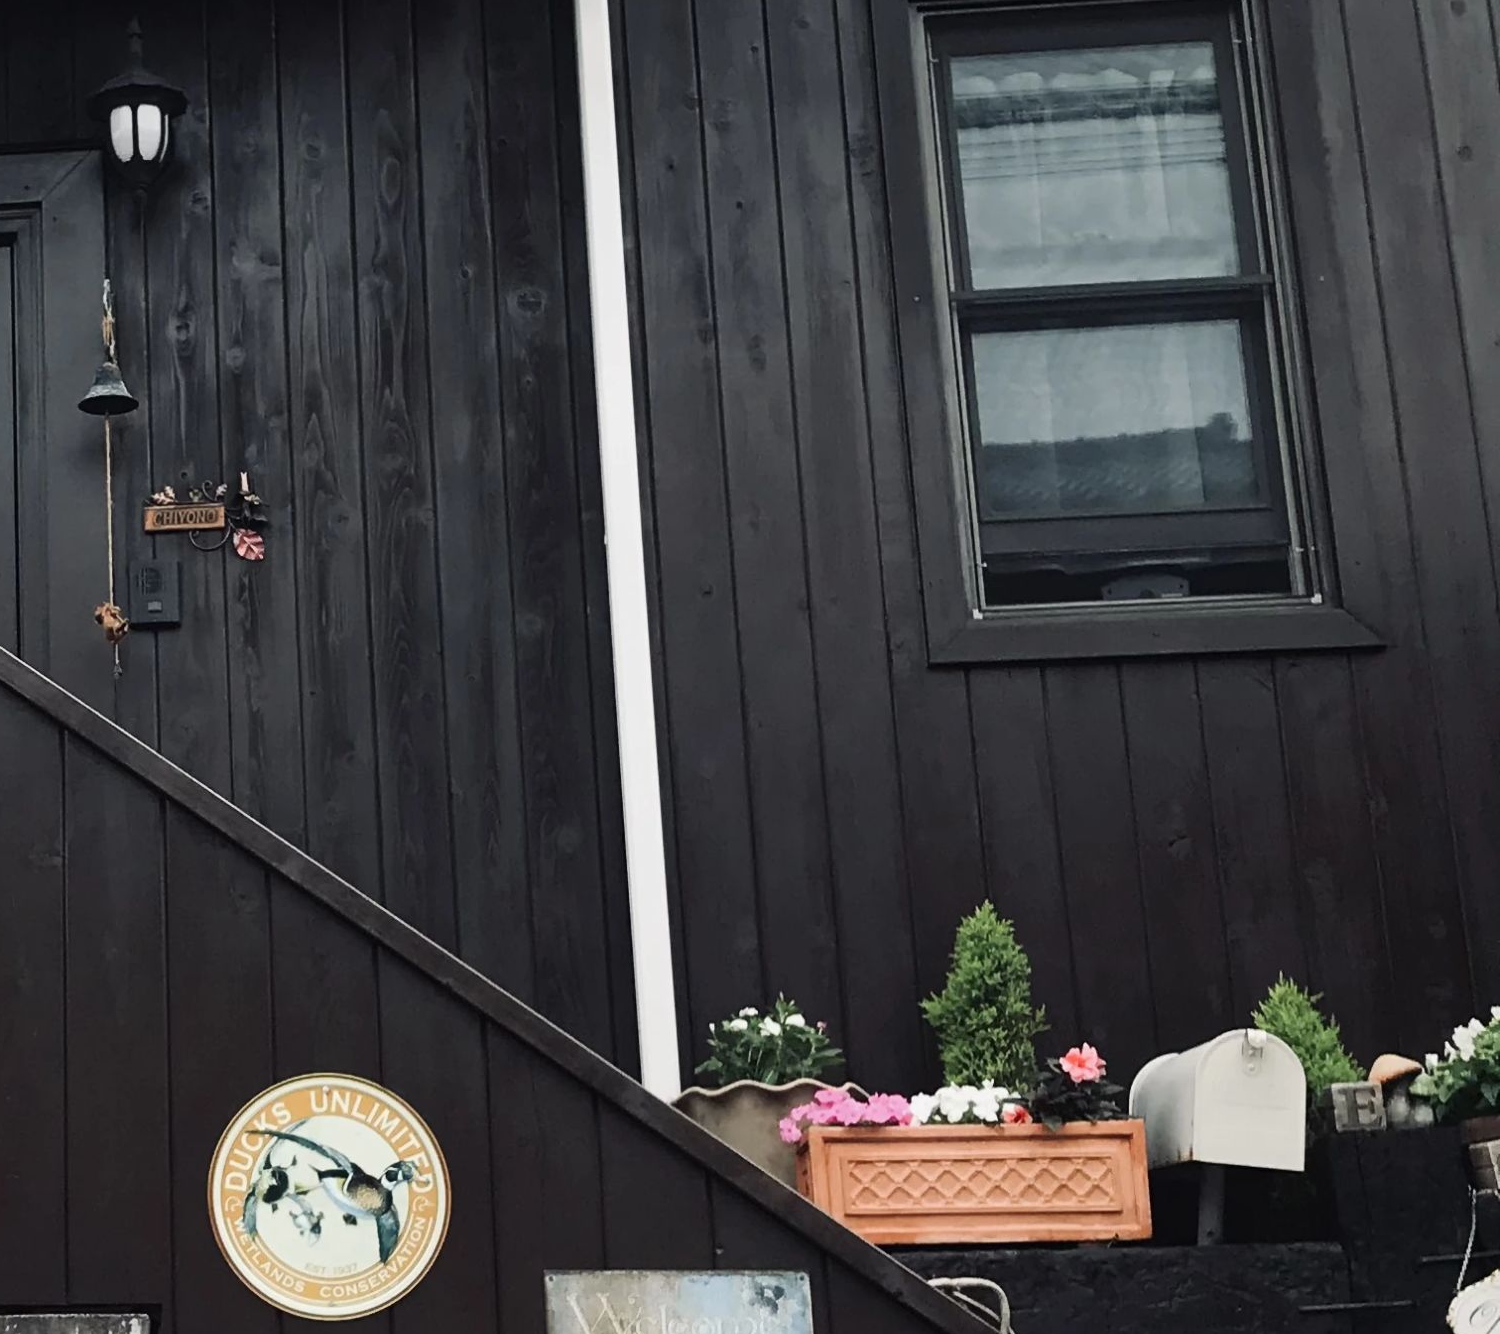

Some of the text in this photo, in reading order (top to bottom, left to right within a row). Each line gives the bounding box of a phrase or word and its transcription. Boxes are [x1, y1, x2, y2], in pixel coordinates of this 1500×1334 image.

[152, 508, 217, 526] CHIYONO
[1338, 1088, 1382, 1129] E
[224, 1090, 435, 1194] DUCKS UNLIMITED
[233, 1216, 426, 1299] WETLANDS CONSERVATION
